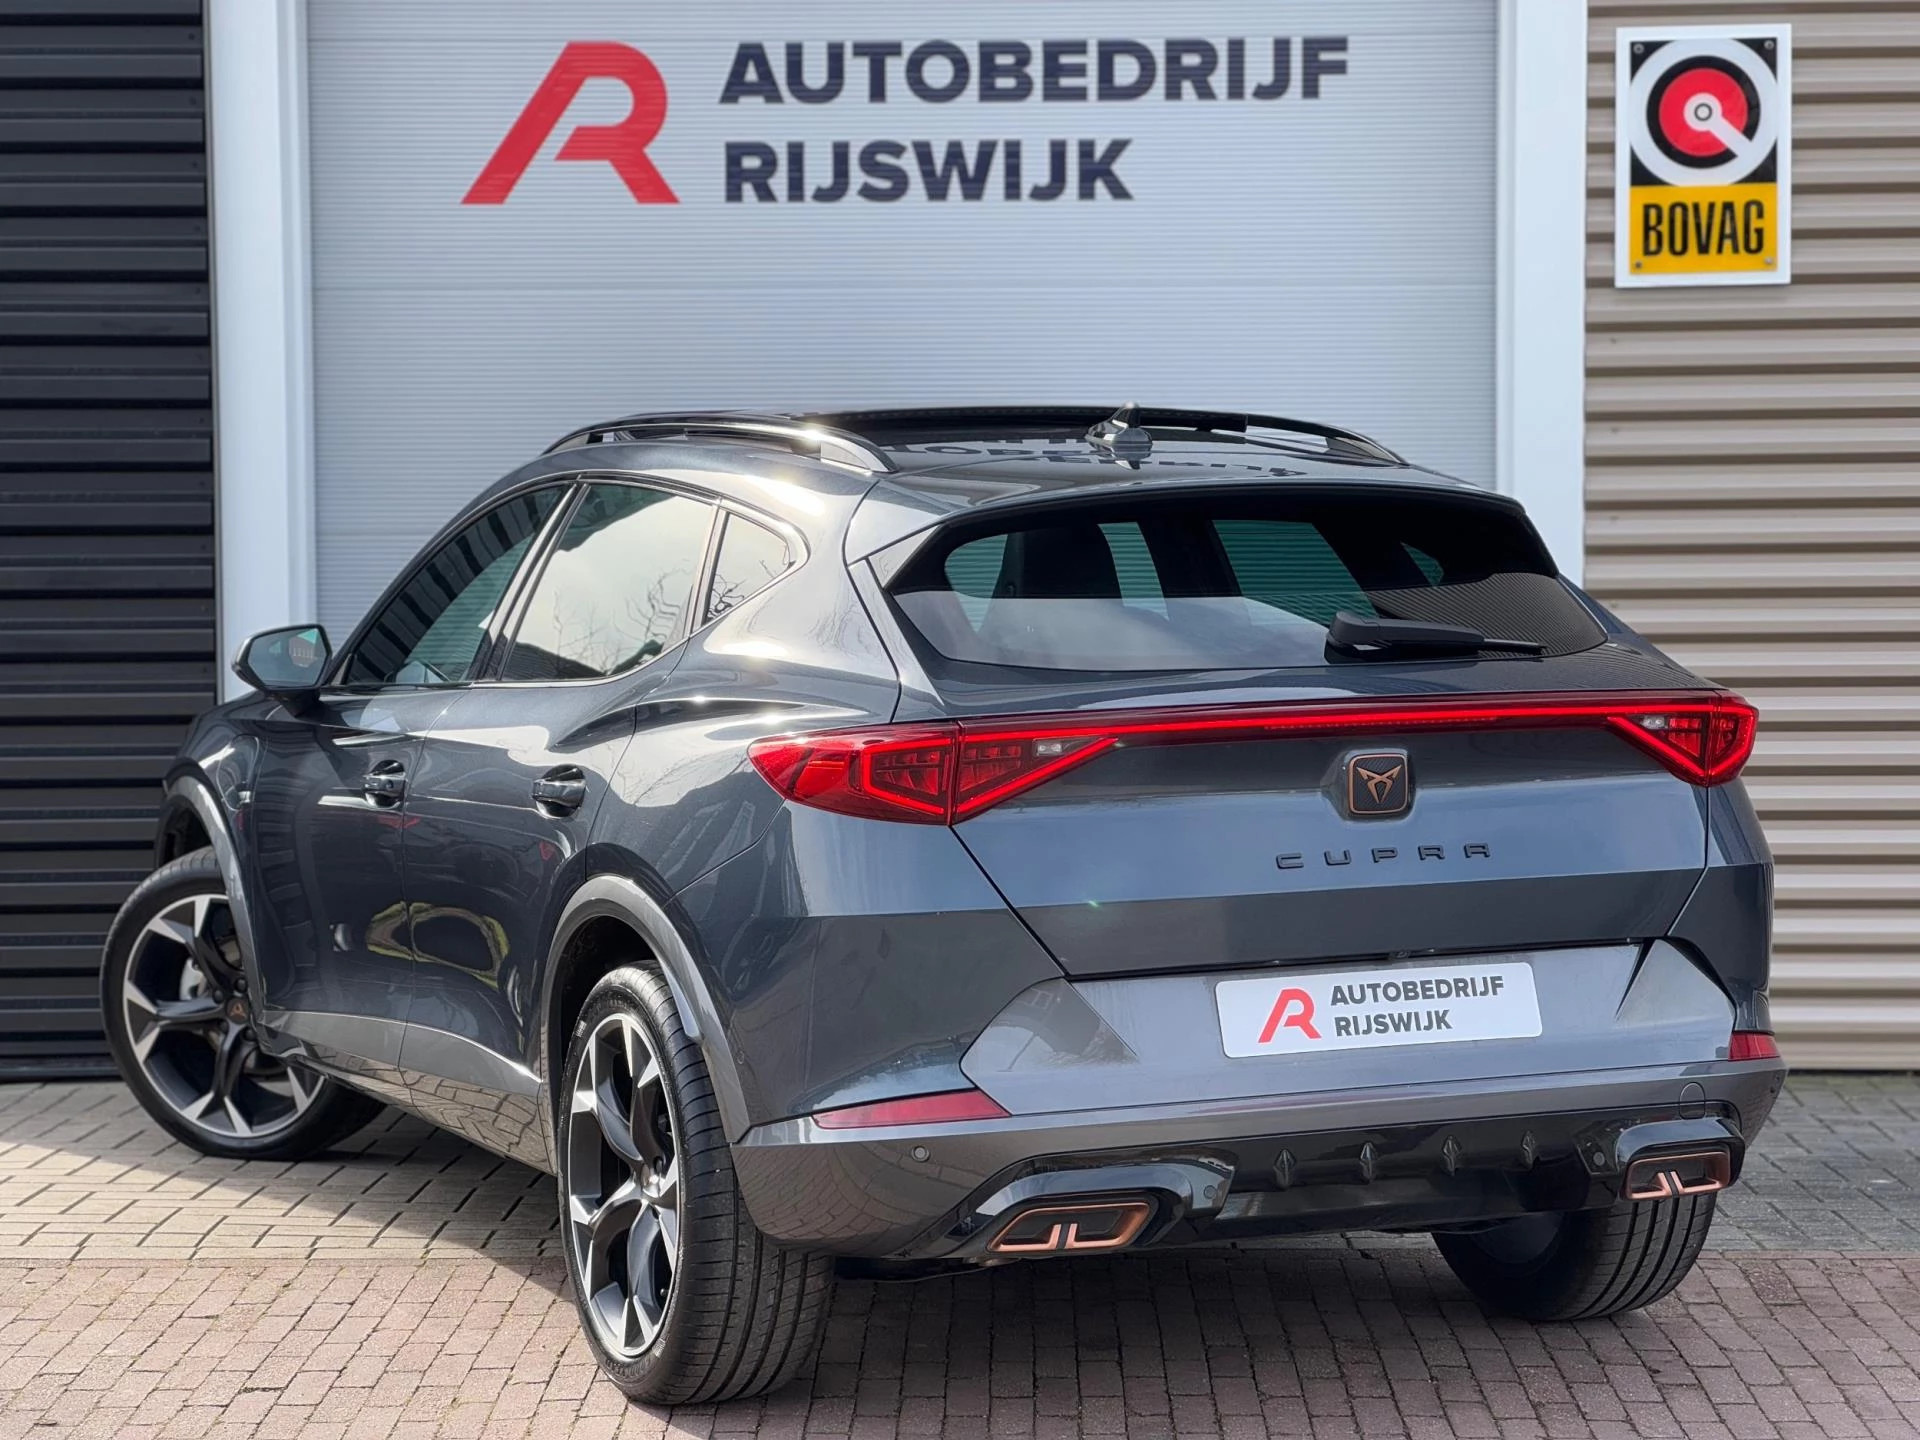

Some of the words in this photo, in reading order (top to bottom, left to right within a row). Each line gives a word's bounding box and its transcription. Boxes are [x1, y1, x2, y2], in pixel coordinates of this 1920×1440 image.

[719, 36, 1349, 105] AUTOBEDRIJF
[724, 138, 1135, 204] RIJSWIJK
[1642, 199, 1765, 257] BOVAG
[1276, 842, 1492, 869] CUPRA
[1330, 975, 1505, 1007] AUTOBEDRIJF
[1334, 1008, 1453, 1037] RIJSWIJK
